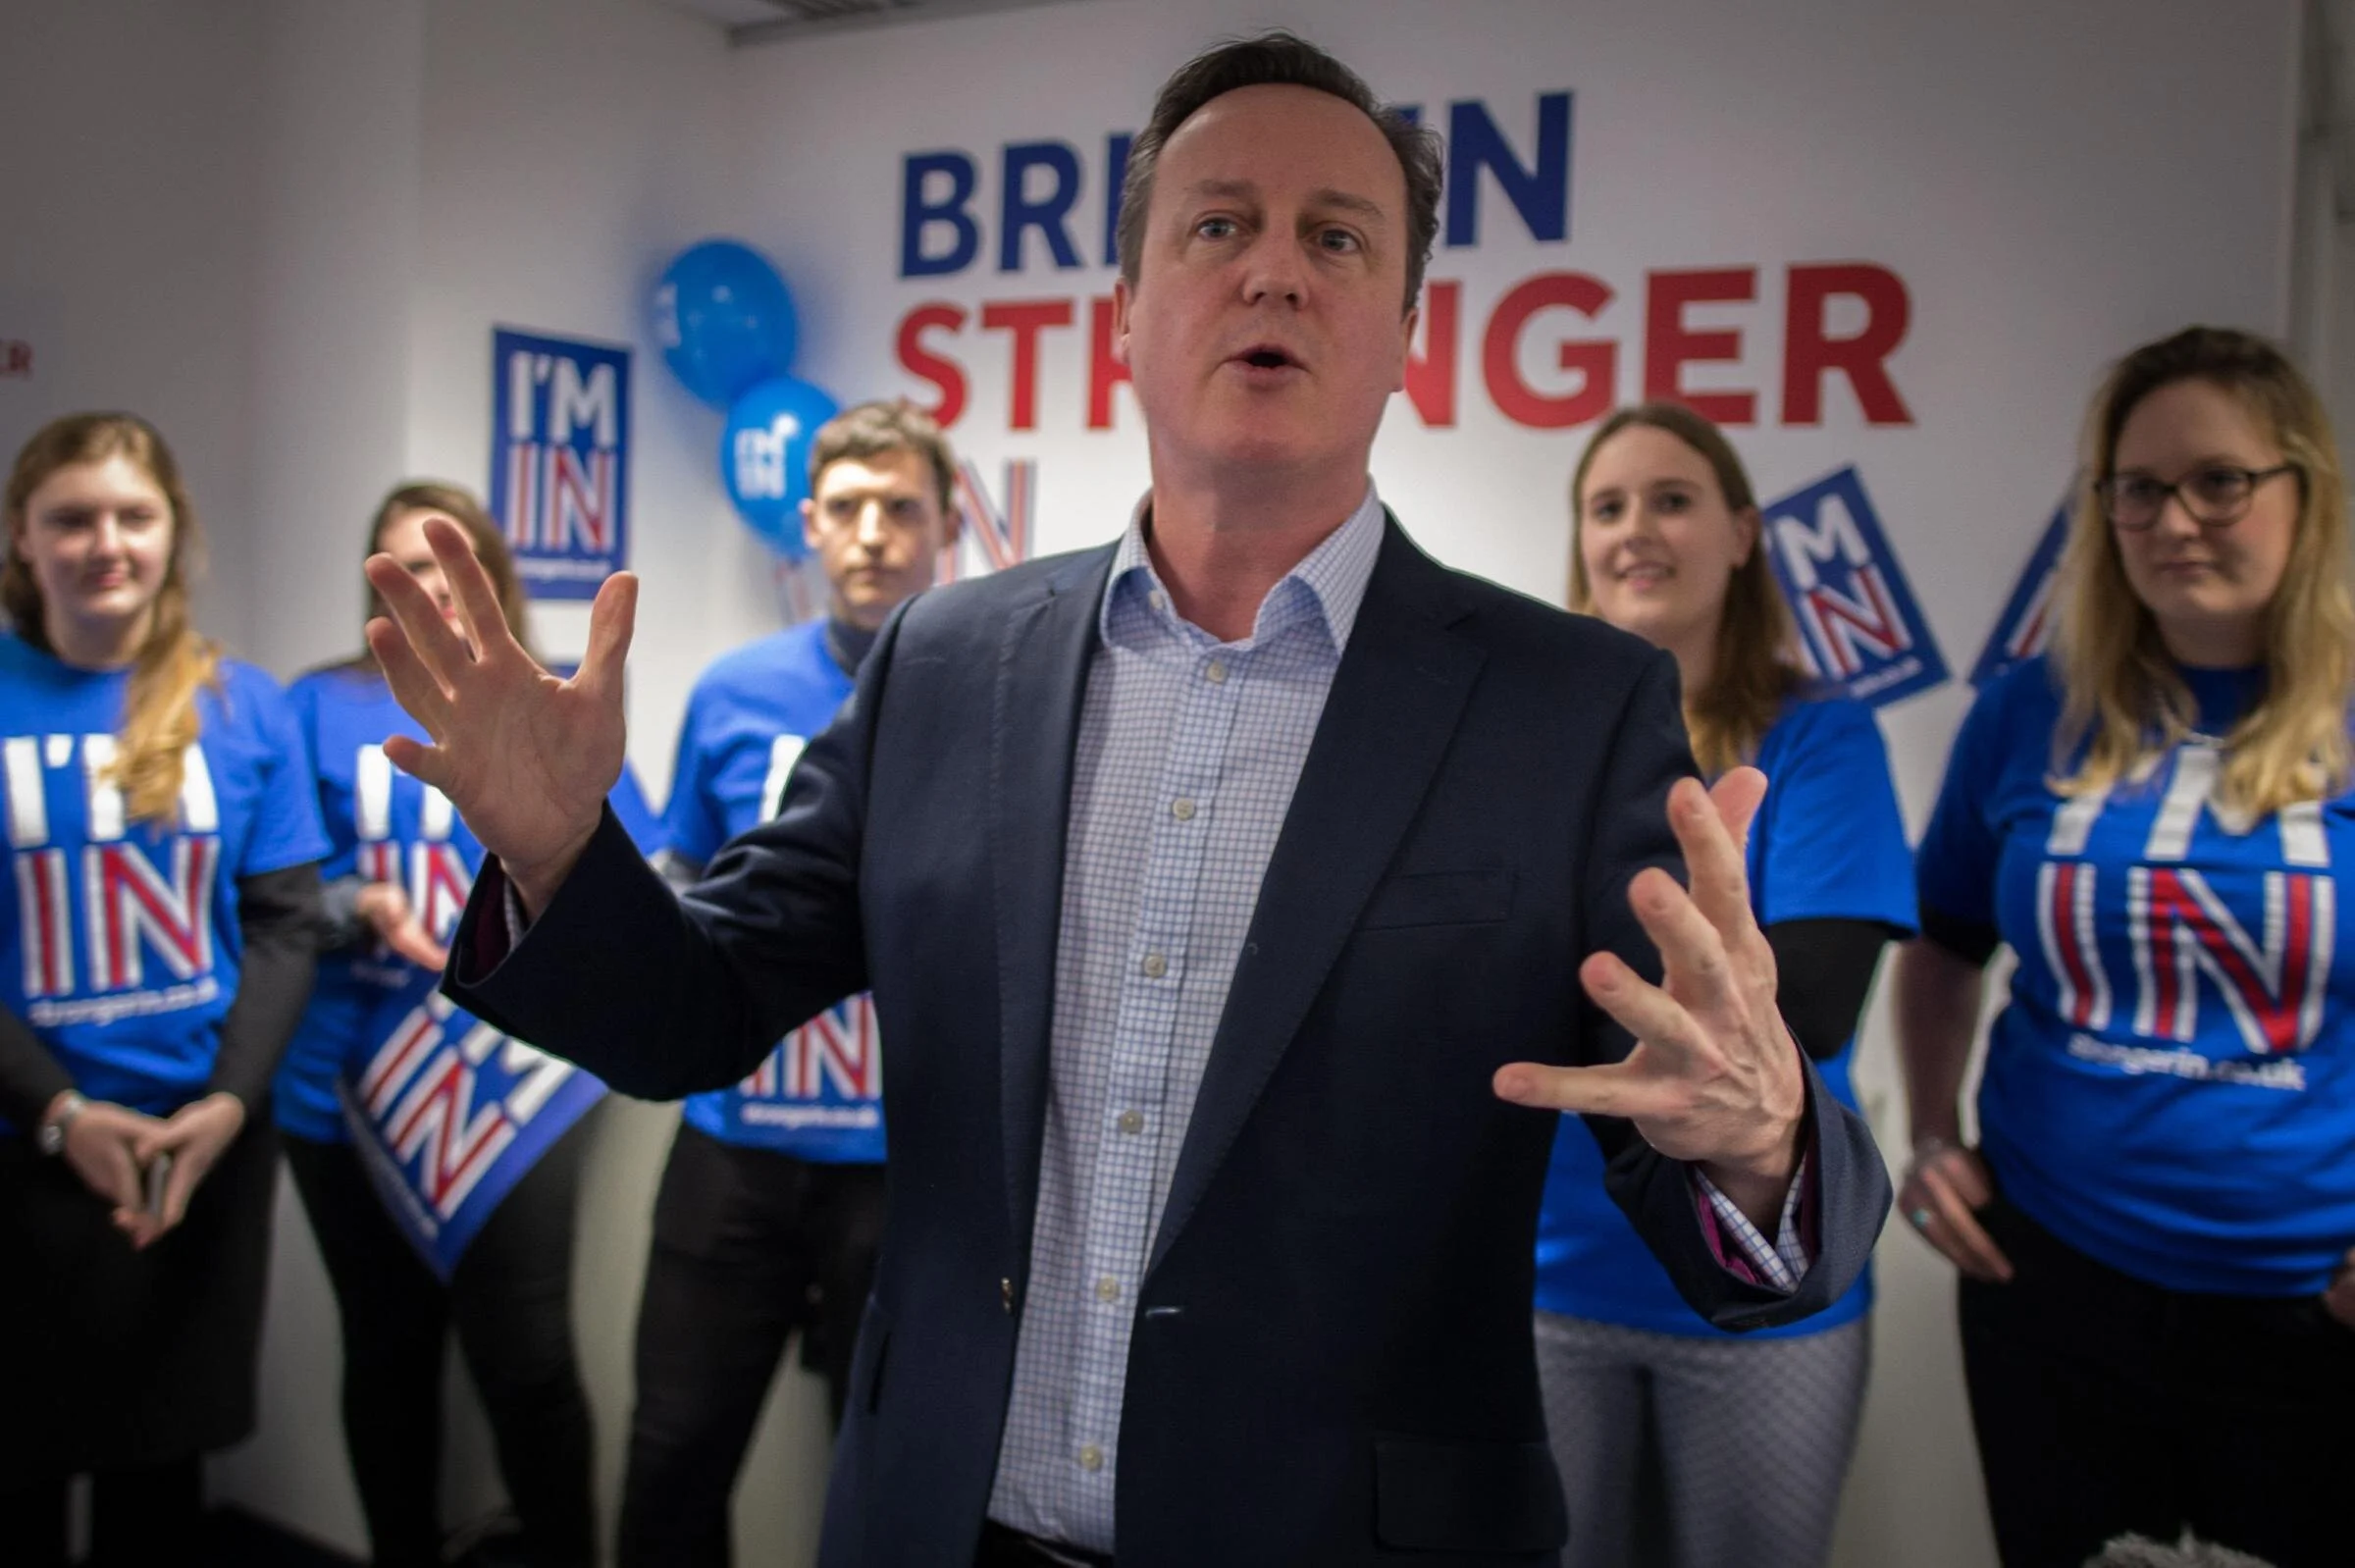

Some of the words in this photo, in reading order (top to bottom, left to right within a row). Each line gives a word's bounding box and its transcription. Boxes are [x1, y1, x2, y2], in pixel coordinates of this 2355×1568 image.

[898, 89, 1575, 280] BRIN
[508, 350, 616, 448] I'M
[505, 443, 616, 553] IN
[15, 834, 221, 999] IN
[2036, 860, 2336, 1055] IN
[357, 1003, 519, 1223] IN
